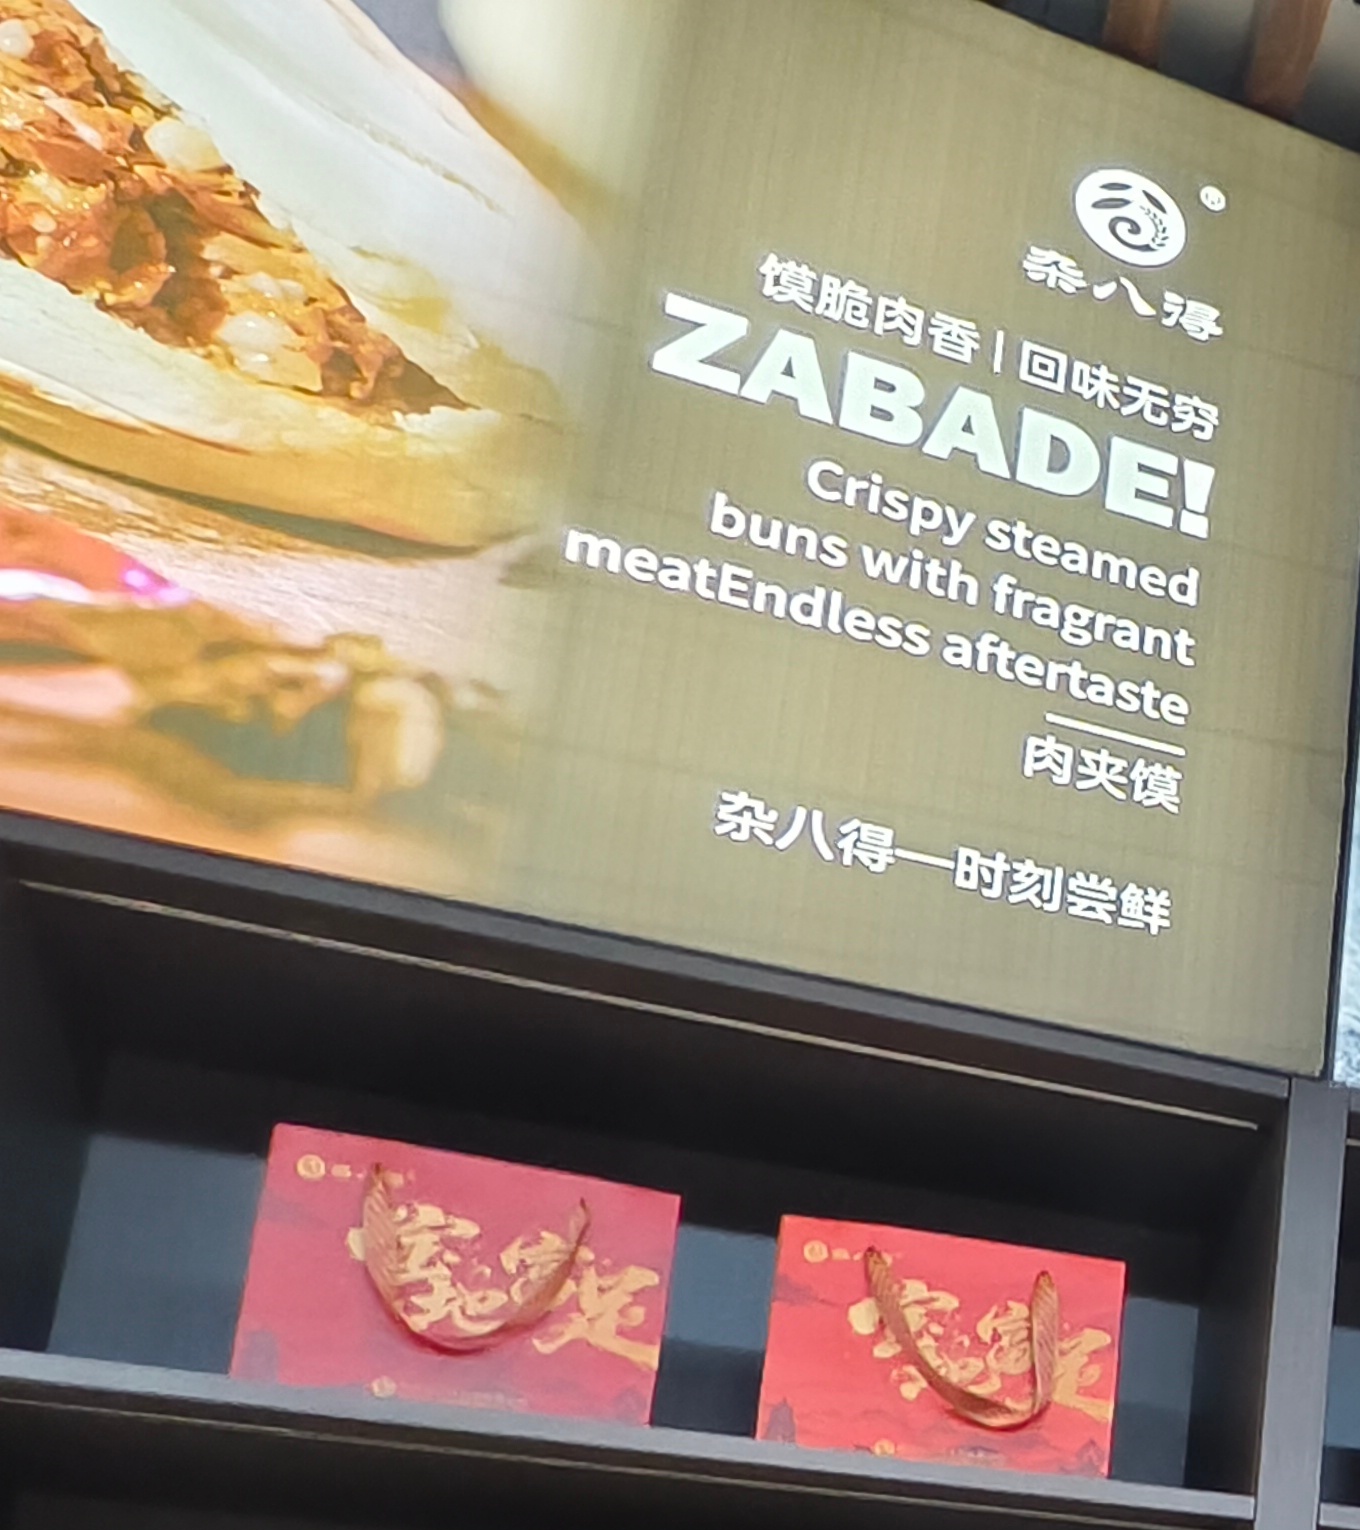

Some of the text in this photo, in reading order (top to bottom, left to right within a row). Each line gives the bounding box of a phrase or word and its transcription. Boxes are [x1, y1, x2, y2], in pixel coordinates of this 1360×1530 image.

[1022, 245, 1223, 344] 杂八得
[651, 293, 1217, 539] ZABADE!
[710, 494, 1197, 667] buns with fragrant
[807, 460, 1200, 607] Crispy steamed
[564, 529, 1190, 727] meatEndless aftertaste
[1022, 736, 1183, 814] 肉夹馍
